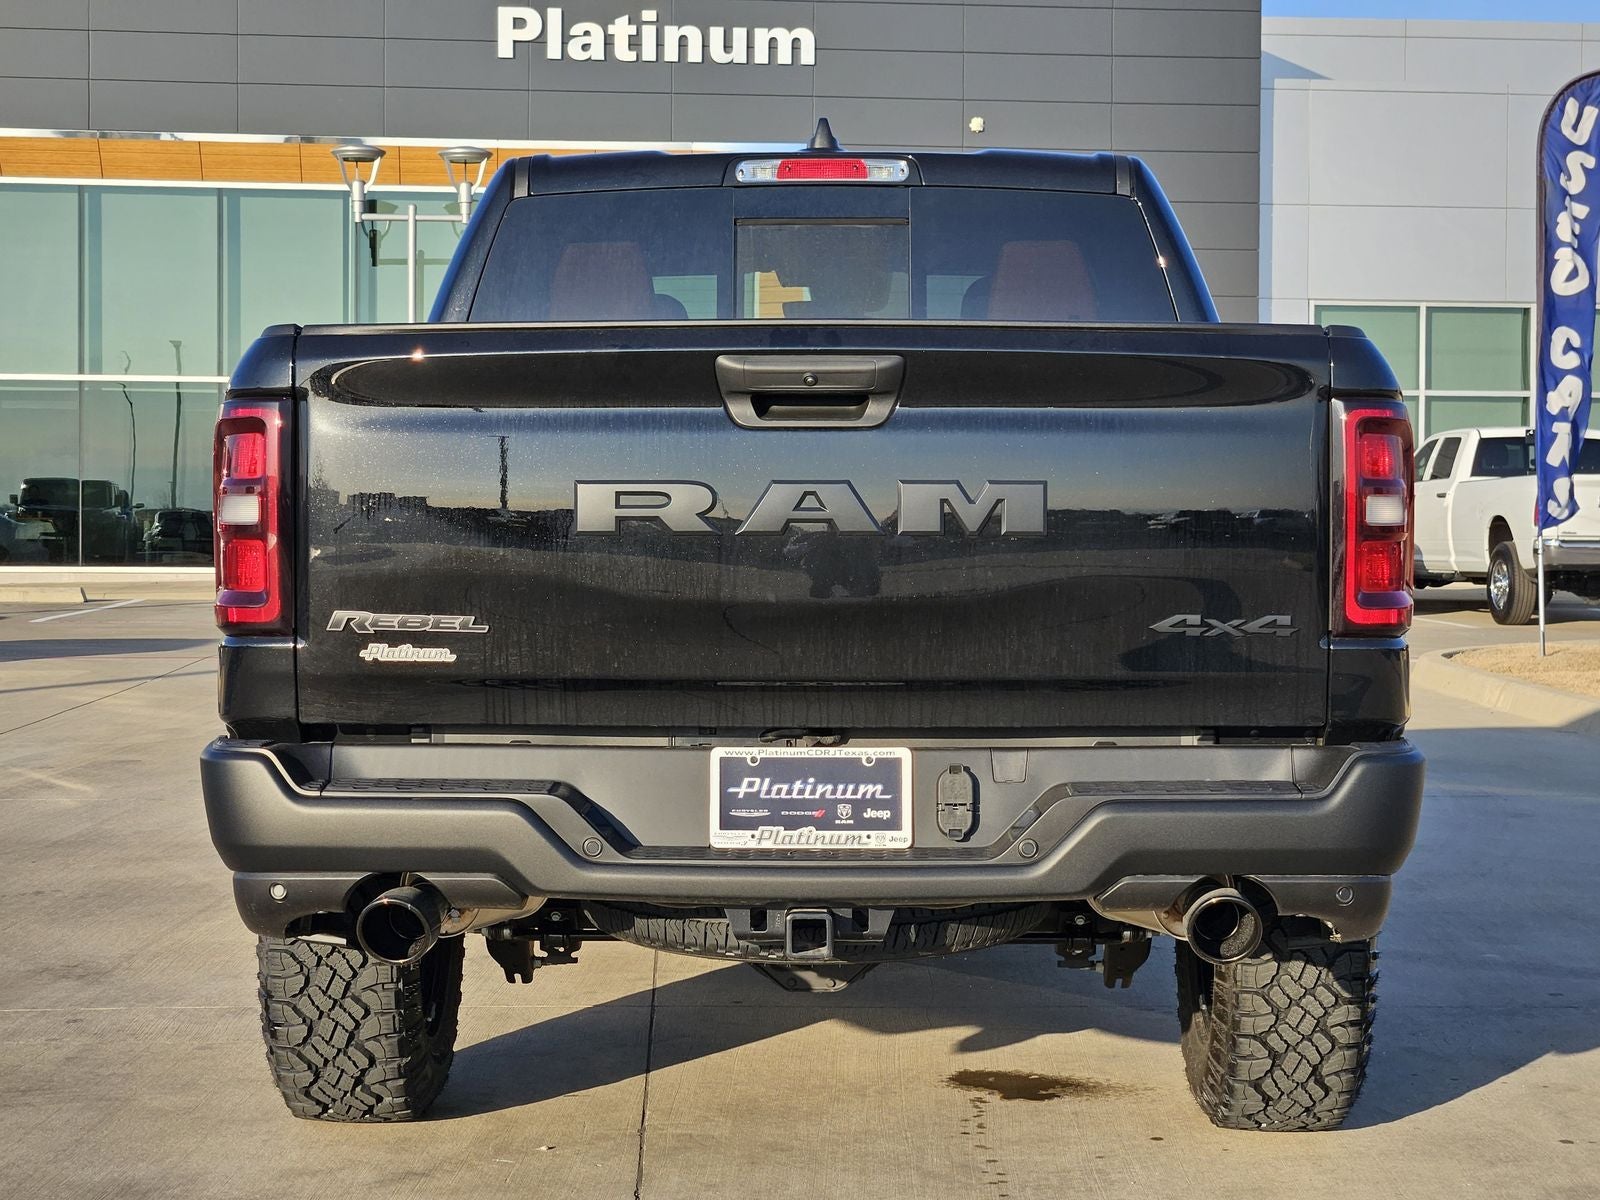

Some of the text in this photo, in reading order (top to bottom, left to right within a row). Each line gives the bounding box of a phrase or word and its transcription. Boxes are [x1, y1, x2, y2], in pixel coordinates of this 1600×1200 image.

[496, 6, 817, 67] Platinum
[1546, 325, 1583, 521] CARS
[575, 480, 1048, 535] RAM
[326, 610, 490, 634] REBEL
[359, 643, 458, 663] Platinum
[724, 748, 896, 757] www.PlatinumCDRJTexas.com
[727, 776, 892, 799] Platinum
[863, 808, 891, 820] Jeep
[749, 829, 872, 846] Platinum
[889, 835, 909, 843] Jeep
